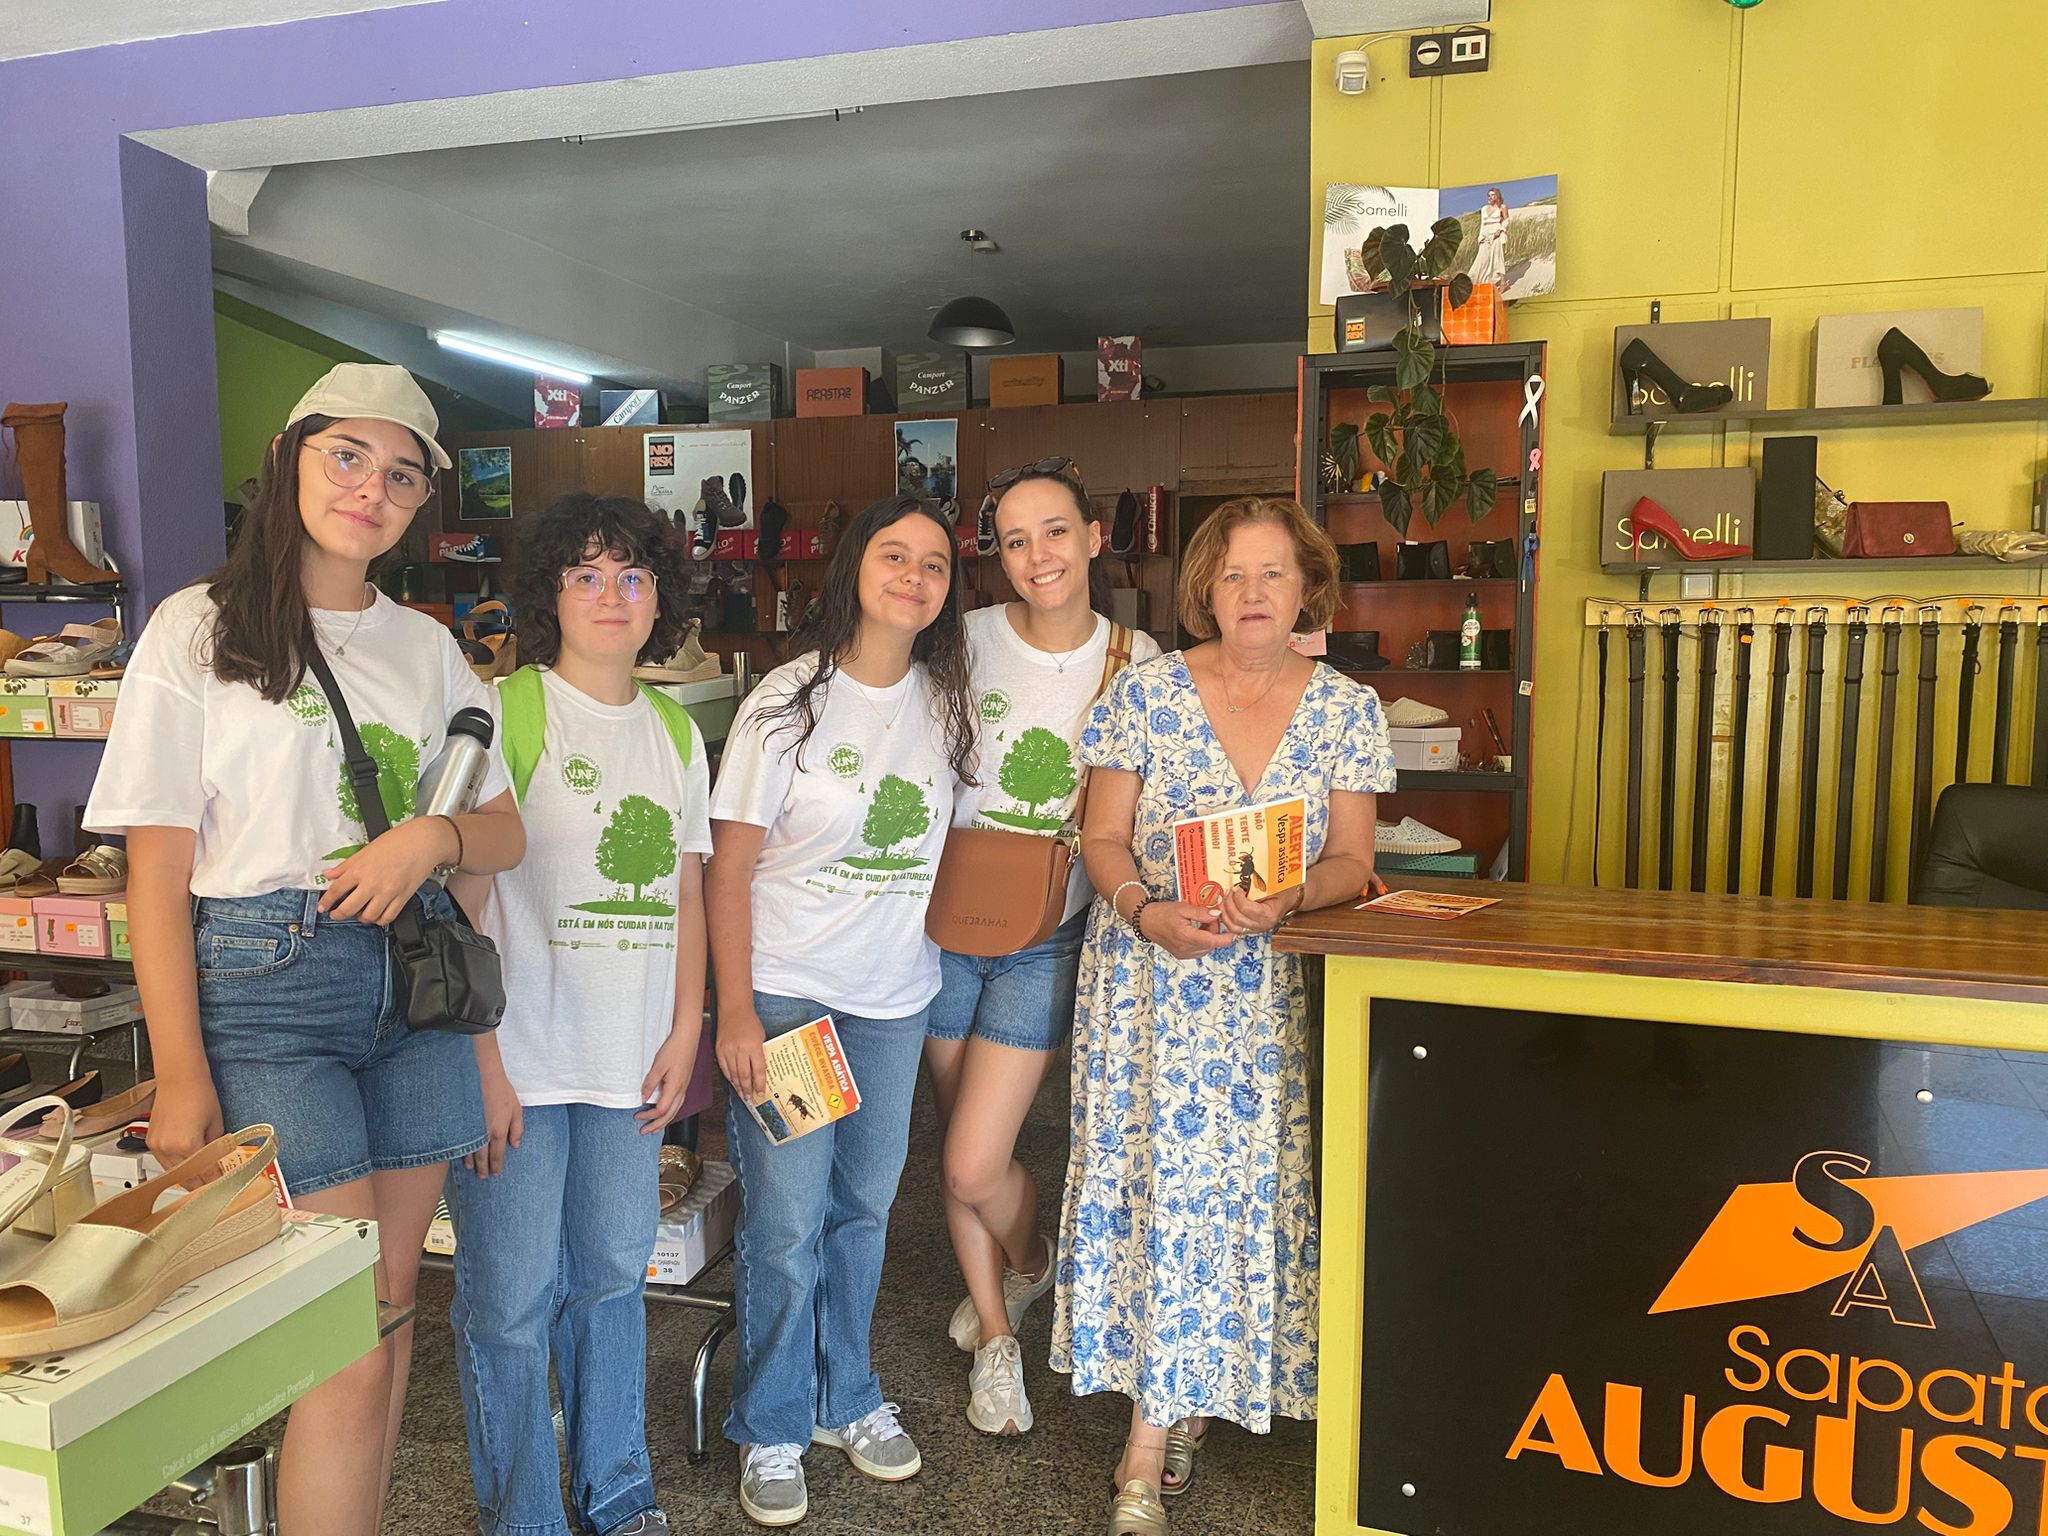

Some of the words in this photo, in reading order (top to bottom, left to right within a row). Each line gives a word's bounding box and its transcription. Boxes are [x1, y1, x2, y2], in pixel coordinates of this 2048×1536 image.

[1356, 202, 1408, 217] Samelli
[1347, 323, 1363, 332] NO
[1108, 359, 1129, 372] Xti
[917, 371, 946, 381] Camport
[726, 382, 752, 391] Camport
[909, 379, 955, 395] PANZER
[547, 389, 567, 401] Xti
[719, 390, 761, 406] PANZER
[613, 394, 643, 424] Camport
[649, 444, 673, 456] NO
[649, 456, 673, 468] RISK
[1615, 512, 1741, 550] Saelli
[1239, 815, 1250, 844] TENTE
[1254, 812, 1266, 831] NÃO
[1277, 813, 1288, 845] Vespa
[1210, 821, 1220, 850] NINHO!
[1225, 818, 1237, 858] ELIMINAR
[1288, 814, 1303, 875] ALERTA
[819, 866, 839, 876] ESTÁ
[840, 870, 850, 879] EM
[1277, 845, 1287, 884] asiática
[557, 917, 581, 929] ESTÁ
[583, 919, 595, 929] EM
[597, 917, 614, 930] NÓS
[617, 919, 647, 930] CUIDAR
[809, 1031, 823, 1060] ESPÉCIE
[822, 1033, 836, 1057] VESPA
[832, 1058, 850, 1093] ASIÁTICA
[20, 1514, 31, 1526] 37
